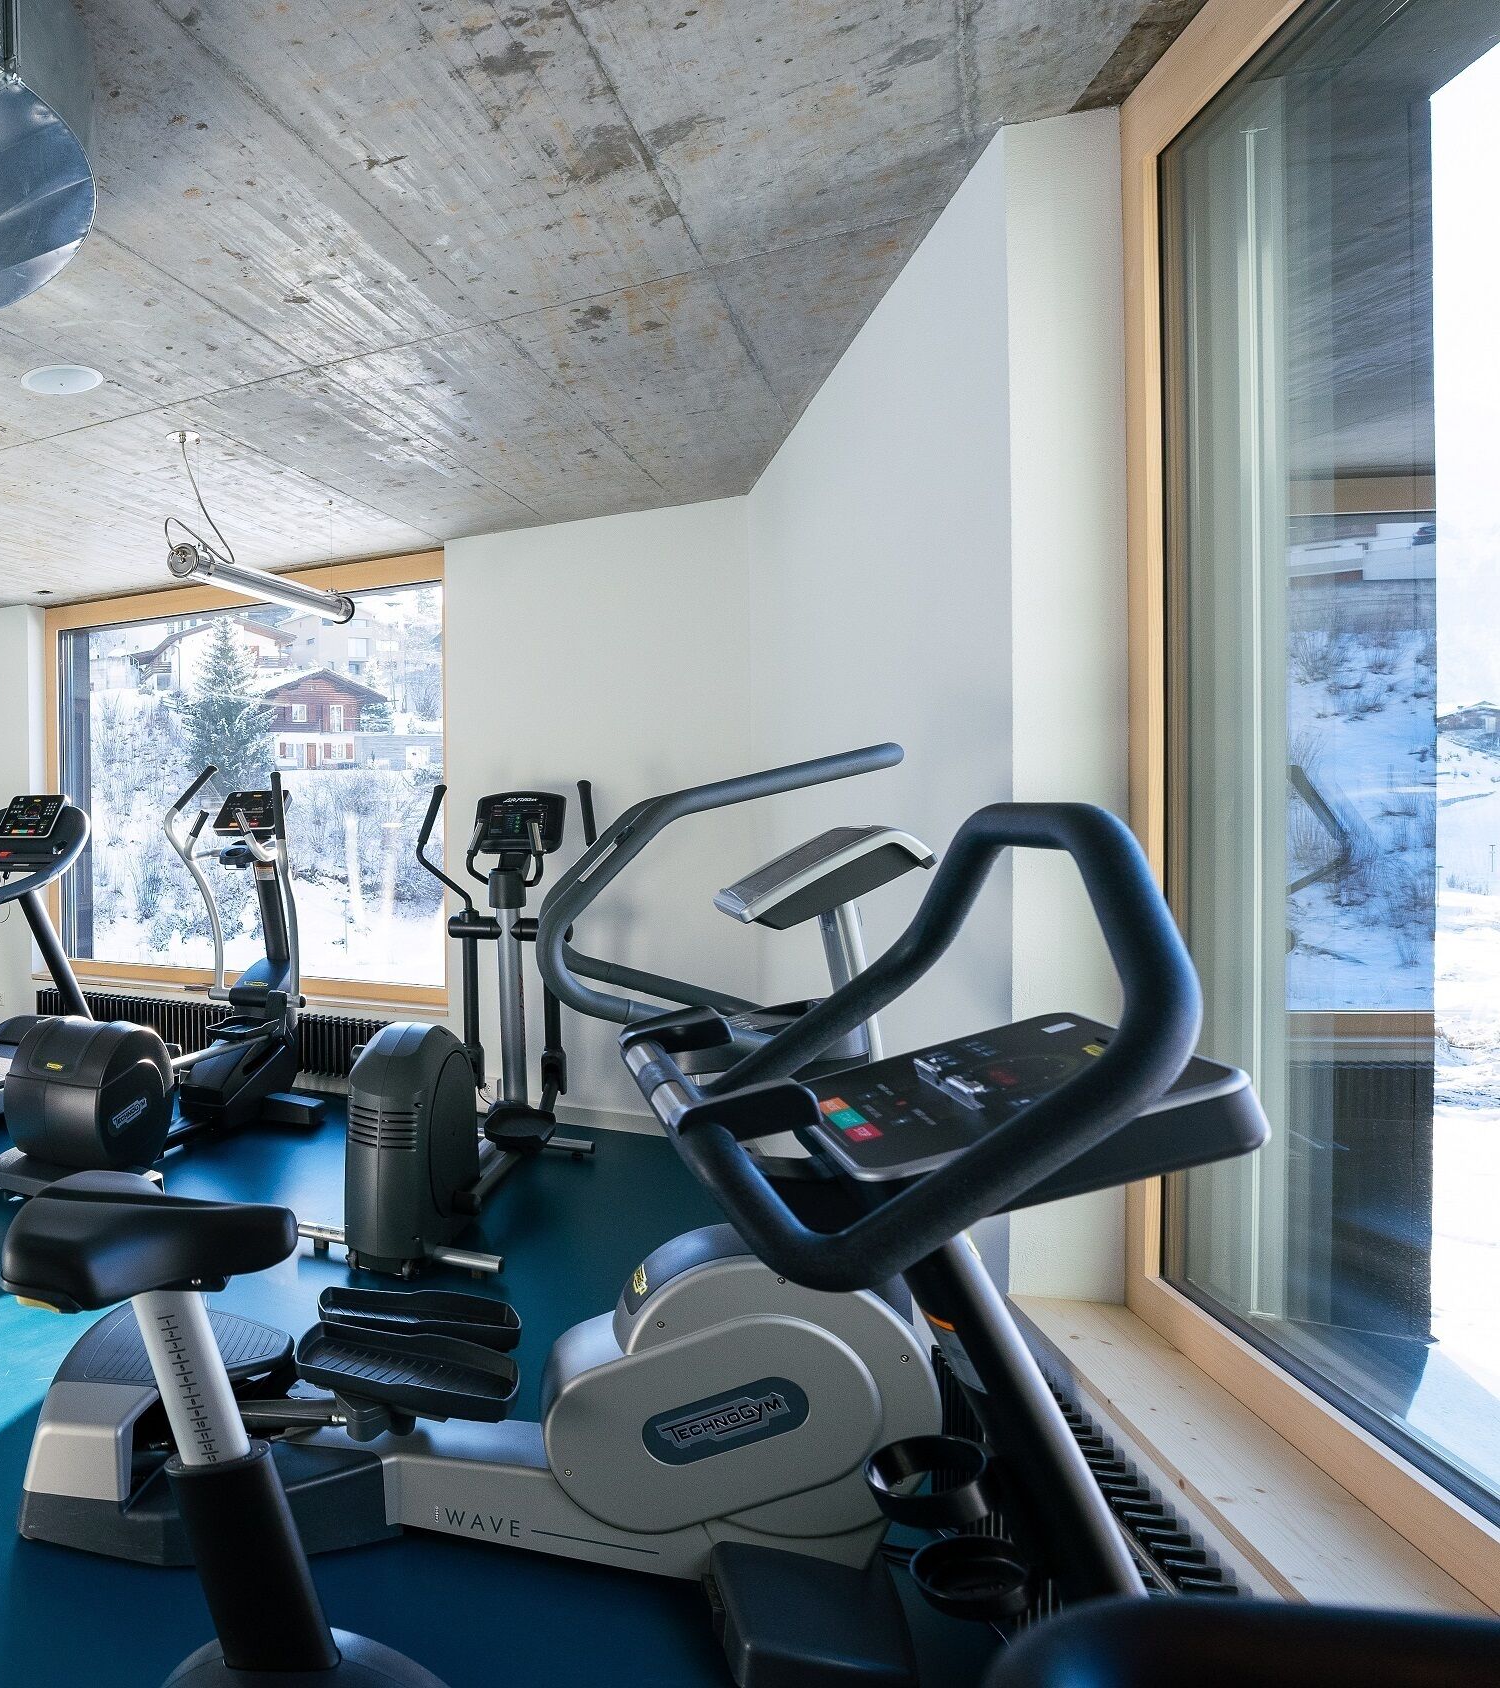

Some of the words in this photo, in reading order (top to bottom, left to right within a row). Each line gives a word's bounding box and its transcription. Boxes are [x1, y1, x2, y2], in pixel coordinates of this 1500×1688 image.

[183, 1375, 189, 1383] 6
[187, 1386, 192, 1394] 7
[191, 1397, 196, 1405] 8
[195, 1409, 200, 1417] 9
[196, 1420, 206, 1428] 10
[661, 1398, 782, 1443] TECHNOGYM
[204, 1443, 213, 1451] 12
[207, 1454, 217, 1462] 13
[445, 1507, 520, 1538] WAVE
